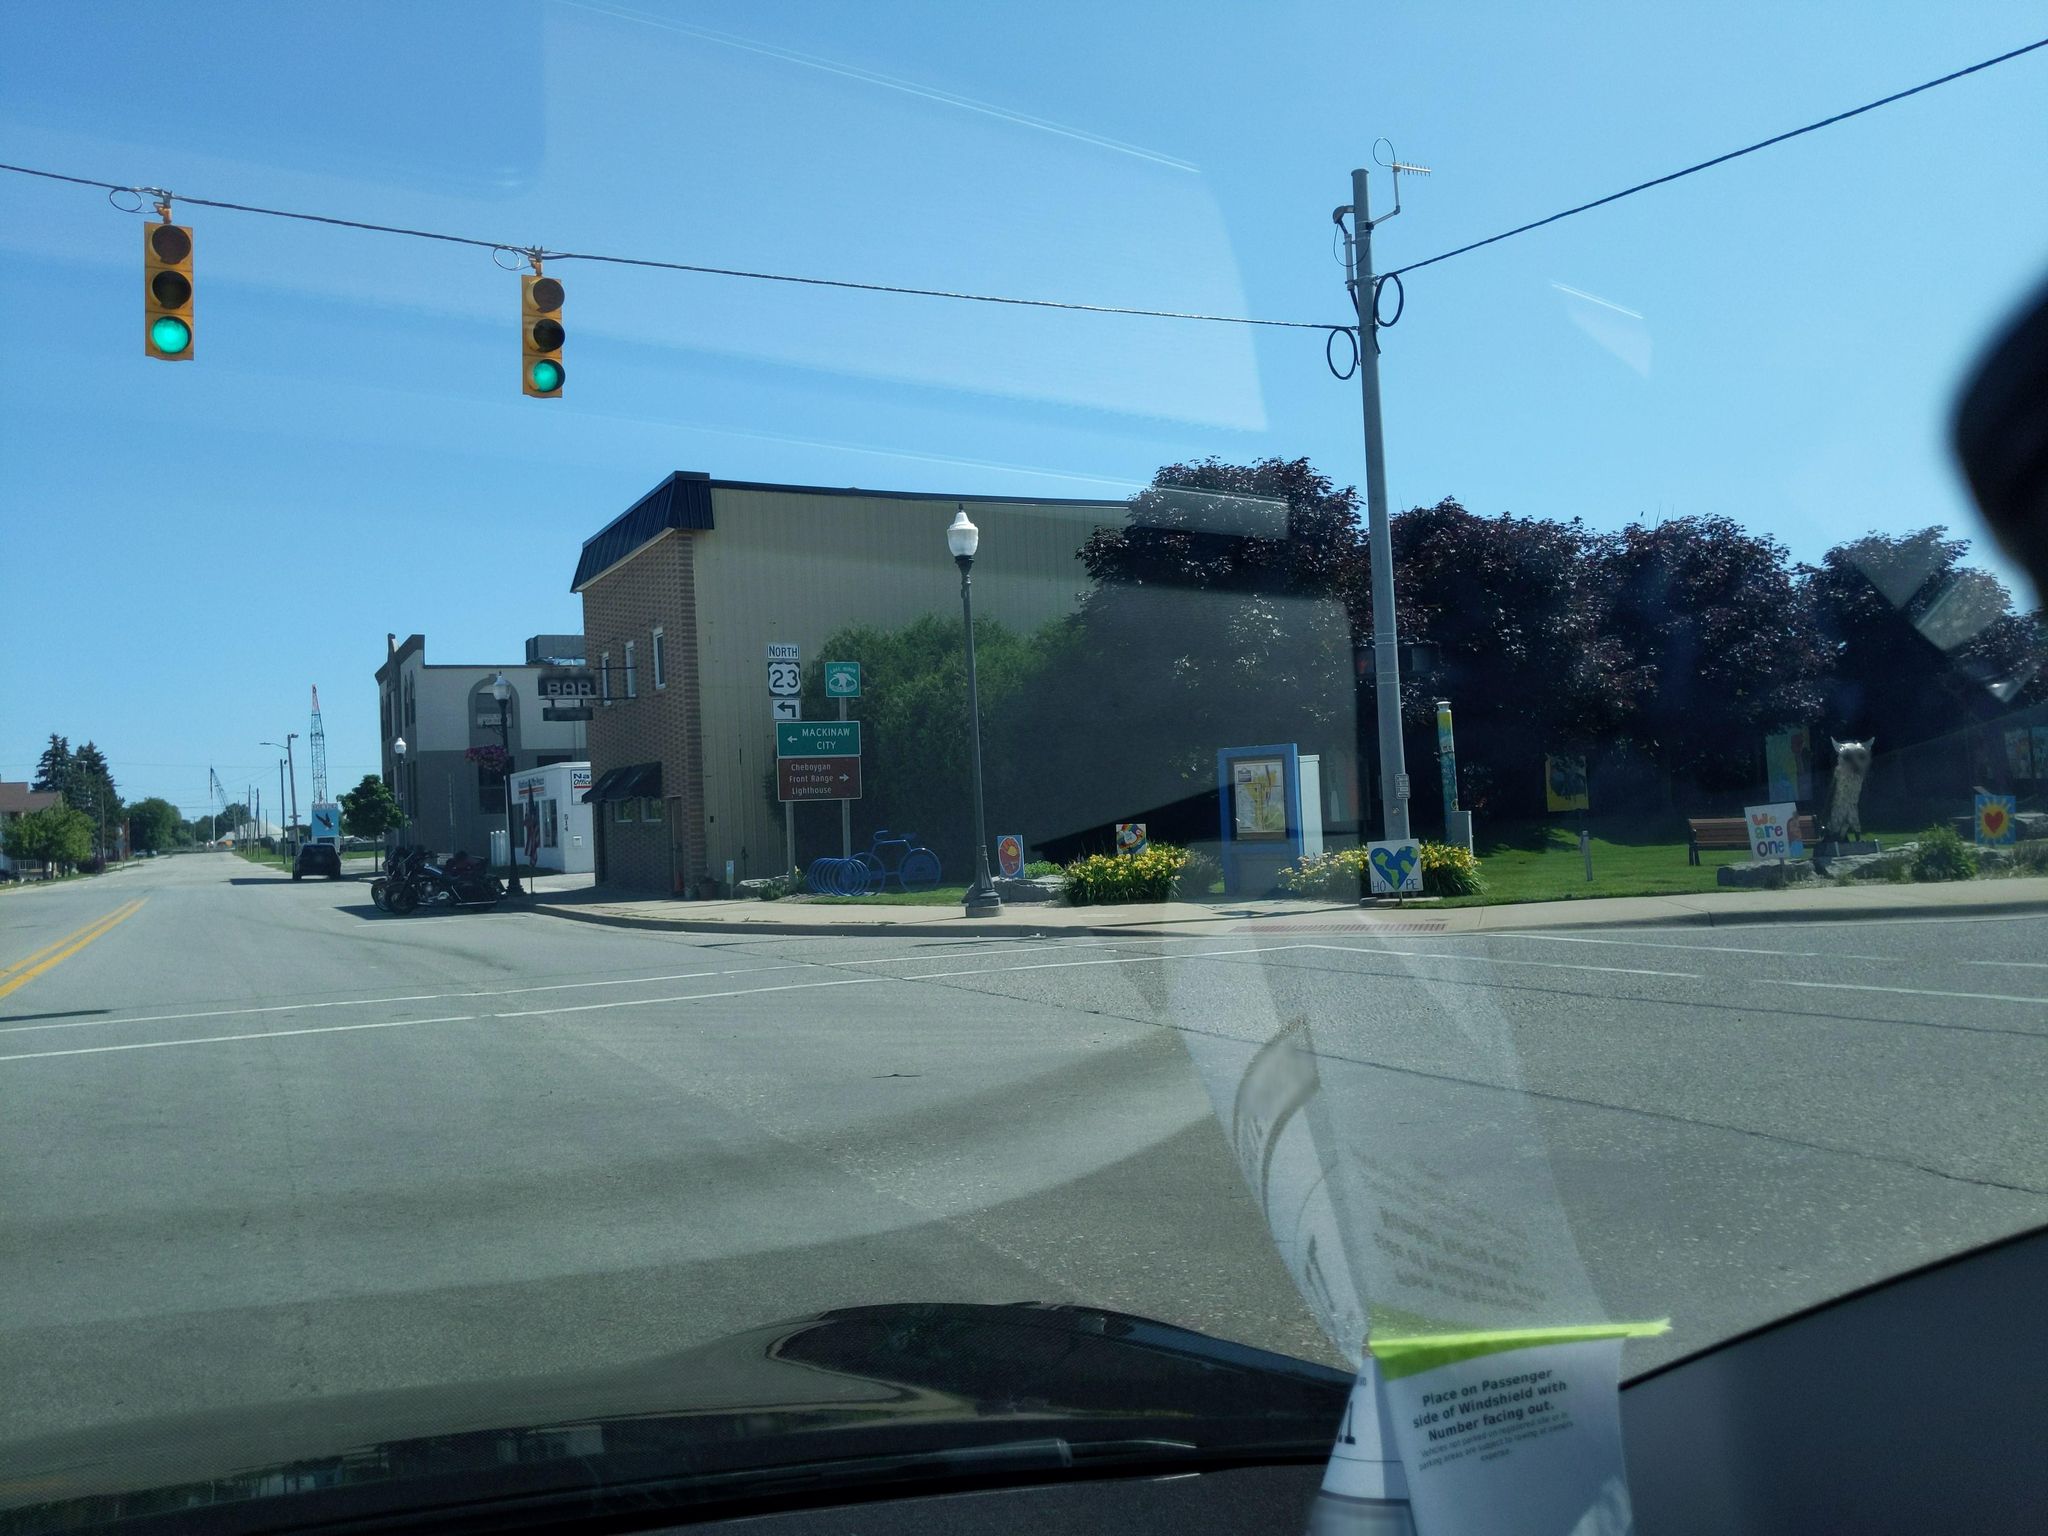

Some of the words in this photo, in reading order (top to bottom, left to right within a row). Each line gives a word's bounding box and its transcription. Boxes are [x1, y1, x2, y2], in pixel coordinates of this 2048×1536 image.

[768, 645, 798, 658] NORTH
[772, 669, 798, 688] 23
[547, 682, 592, 697] BAR
[802, 728, 850, 737] MACKINAW
[816, 741, 837, 750] CITY
[791, 763, 831, 772] Cheboygan
[789, 775, 808, 783] Front
[810, 774, 834, 783] Range
[792, 786, 832, 796] Lighthouse
[1751, 813, 1777, 826] We
[1754, 825, 1784, 839] are
[1422, 1389, 1457, 1407] Place
[1461, 1385, 1478, 1397] on
[1481, 1369, 1552, 1391] Passenger
[1413, 1411, 1439, 1429] side
[1442, 1404, 1455, 1420] of
[1458, 1386, 1533, 1415] Windshield
[1537, 1380, 1567, 1396] with
[1427, 1420, 1479, 1441] Number
[1482, 1408, 1524, 1426] facing
[1527, 1400, 1554, 1415] out.
